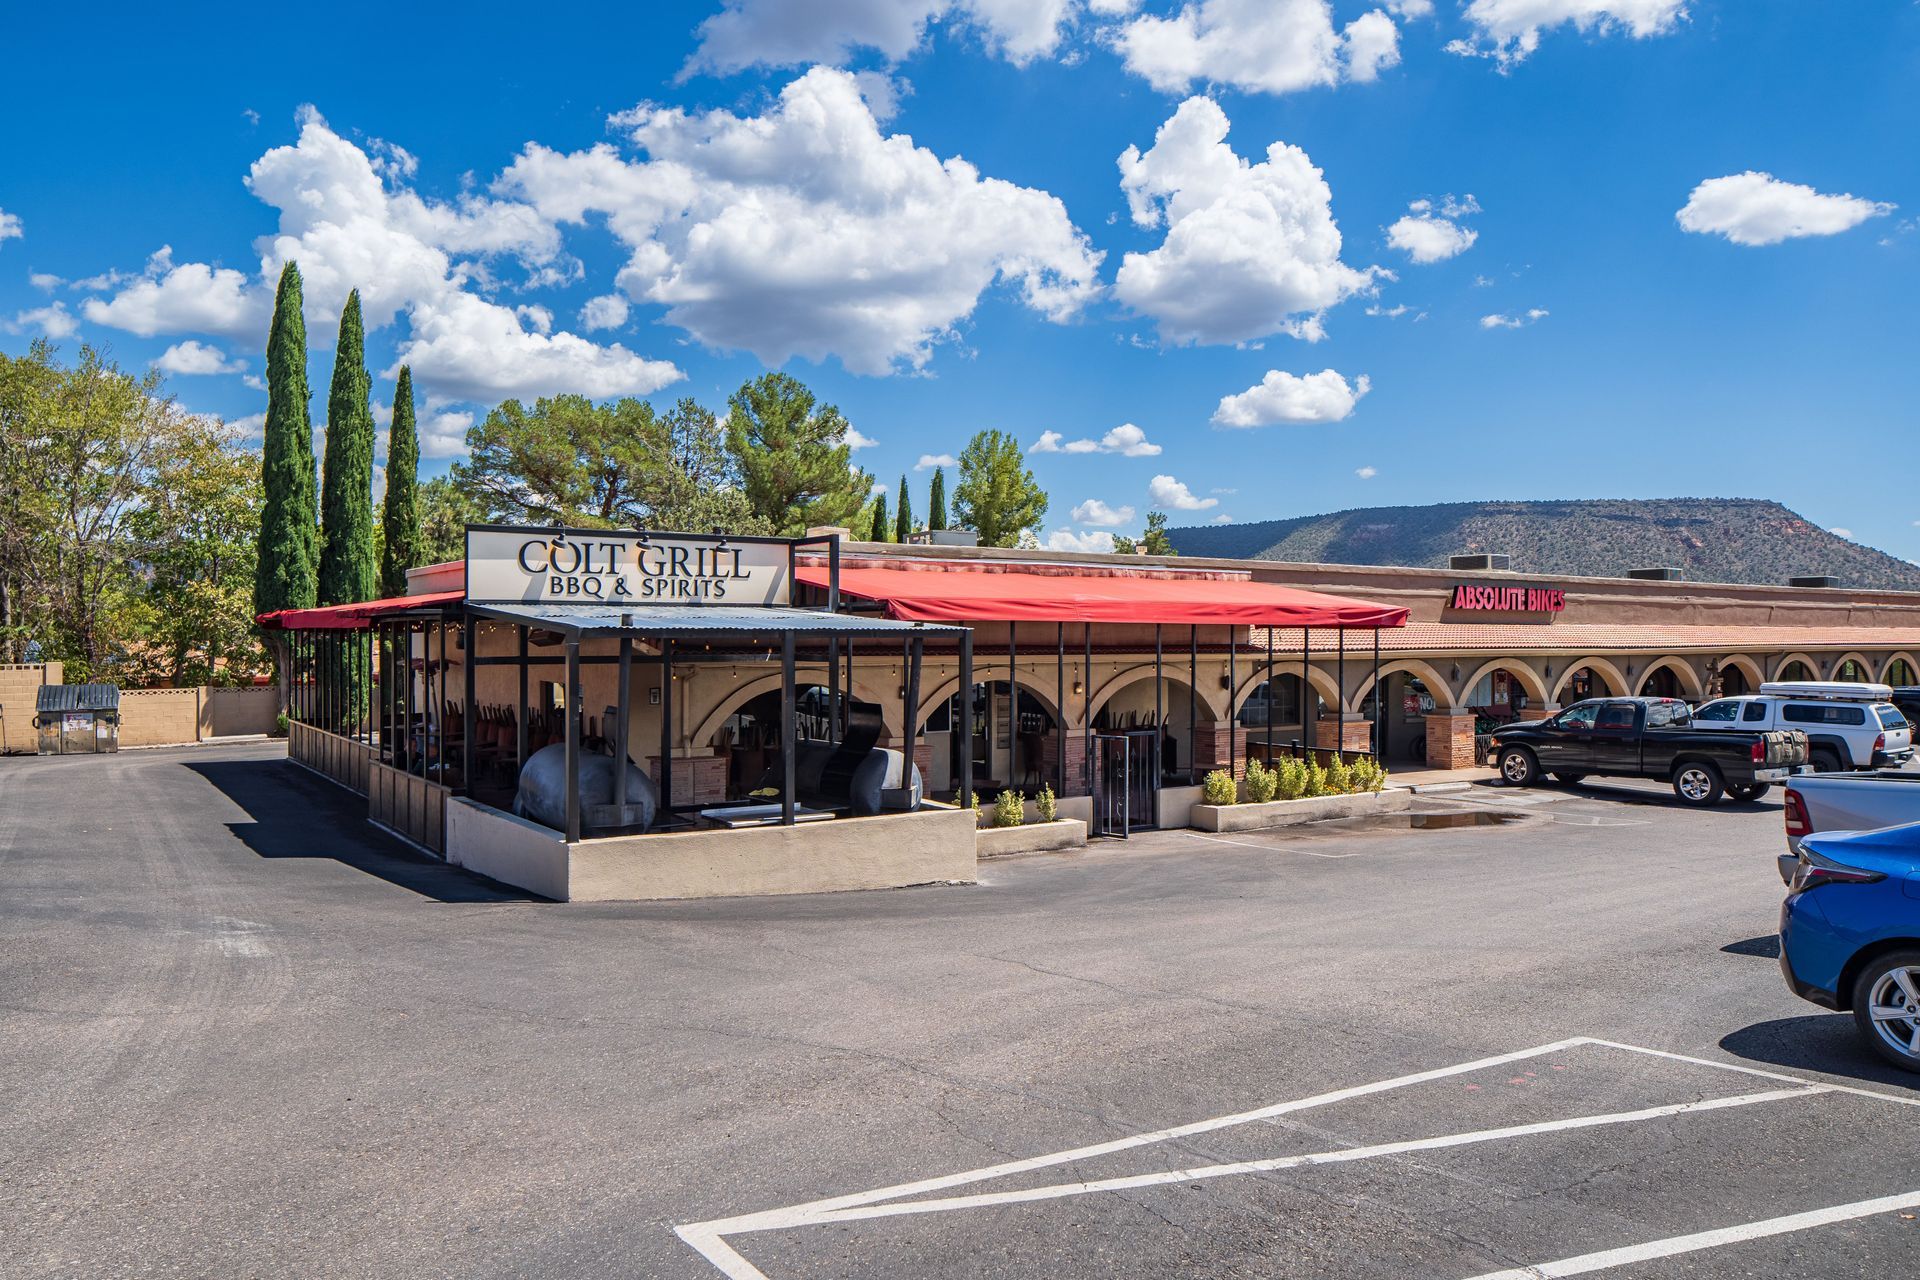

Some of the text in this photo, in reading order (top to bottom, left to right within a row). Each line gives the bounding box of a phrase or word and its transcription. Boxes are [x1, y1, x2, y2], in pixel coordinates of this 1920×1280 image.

[518, 540, 751, 579] COLT GRILL
[550, 576, 726, 599] BBQ & SPIRITS
[1454, 586, 1566, 612] ABSOLUTE BIKES
